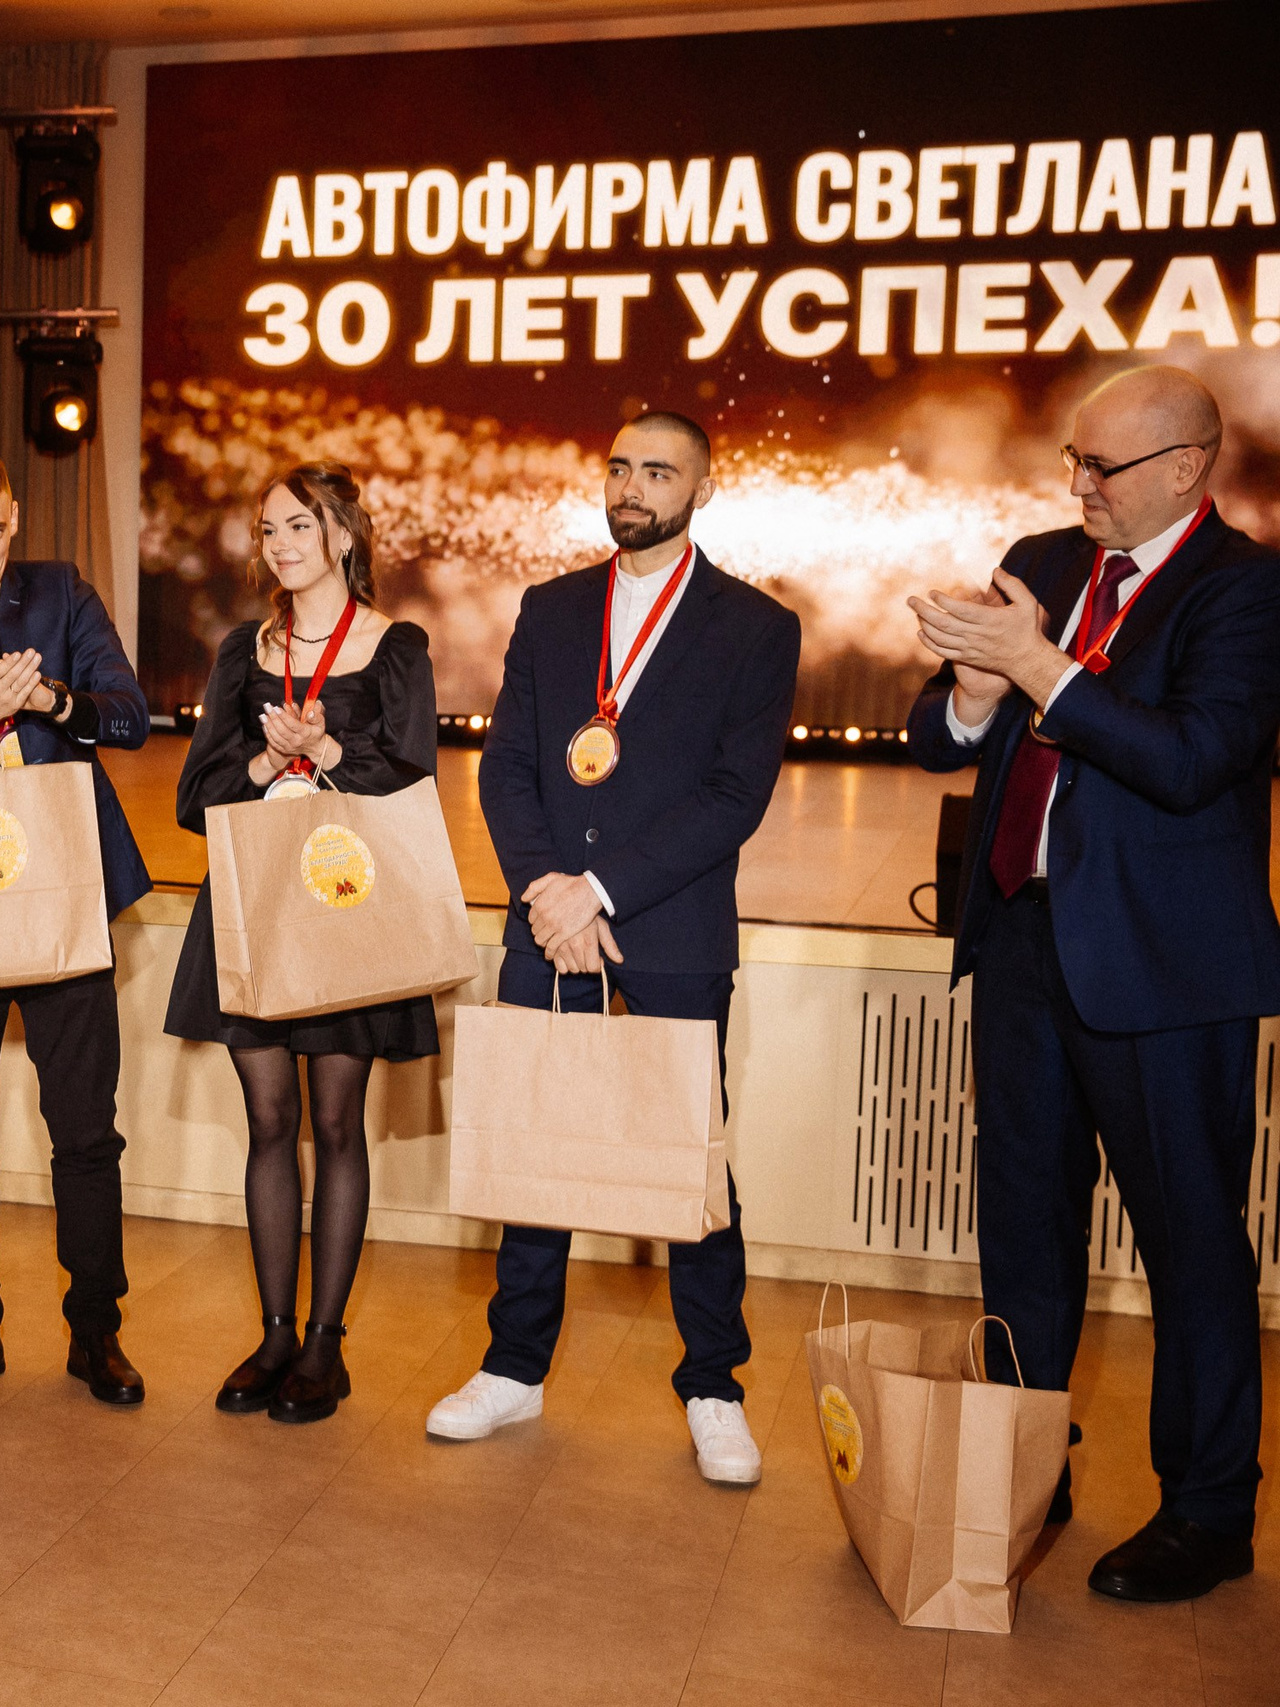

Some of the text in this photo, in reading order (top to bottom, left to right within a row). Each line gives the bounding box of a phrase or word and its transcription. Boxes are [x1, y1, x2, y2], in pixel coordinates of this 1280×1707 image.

[260, 131, 1277, 259] АВТОФИРМА СВЕТЛАНА
[243, 253, 1280, 366] 30 ЛЕТ УСПЕХА!
